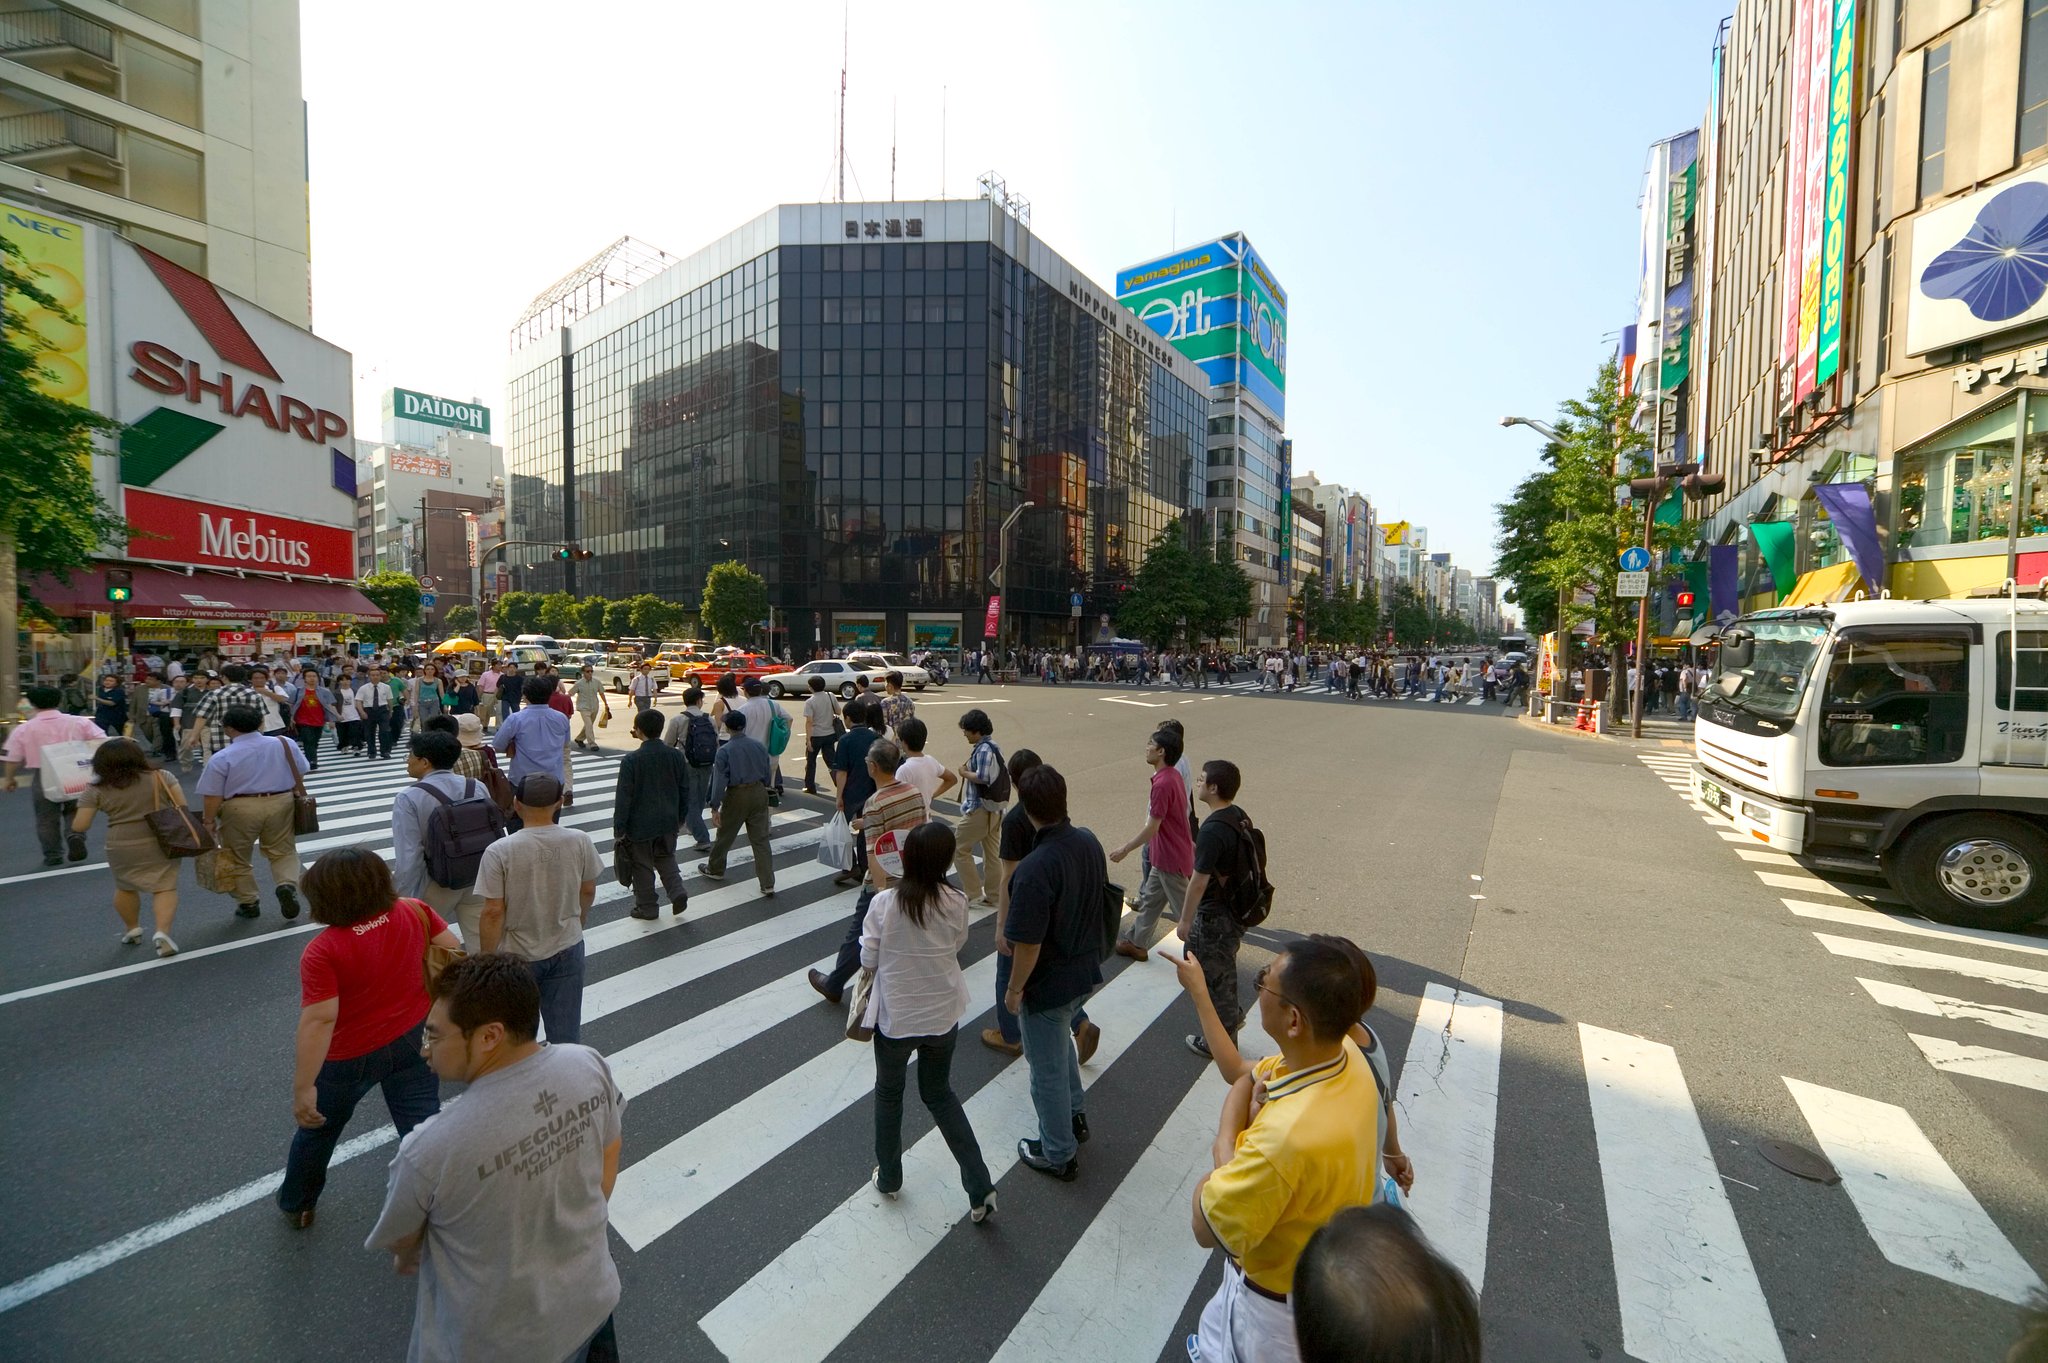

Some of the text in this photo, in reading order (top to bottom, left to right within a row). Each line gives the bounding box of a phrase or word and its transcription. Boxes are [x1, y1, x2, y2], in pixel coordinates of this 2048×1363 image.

[7, 212, 73, 240] NEC
[845, 219, 923, 239] 日本通運
[1069, 280, 1173, 369] NIPPON EXPRESS
[129, 341, 348, 444] SHARP
[198, 513, 311, 568] Mebius
[477, 1095, 601, 1181] LIFEGUARD
[513, 1117, 591, 1176] MOUNTAIN
[526, 1135, 585, 1181] HELPER
